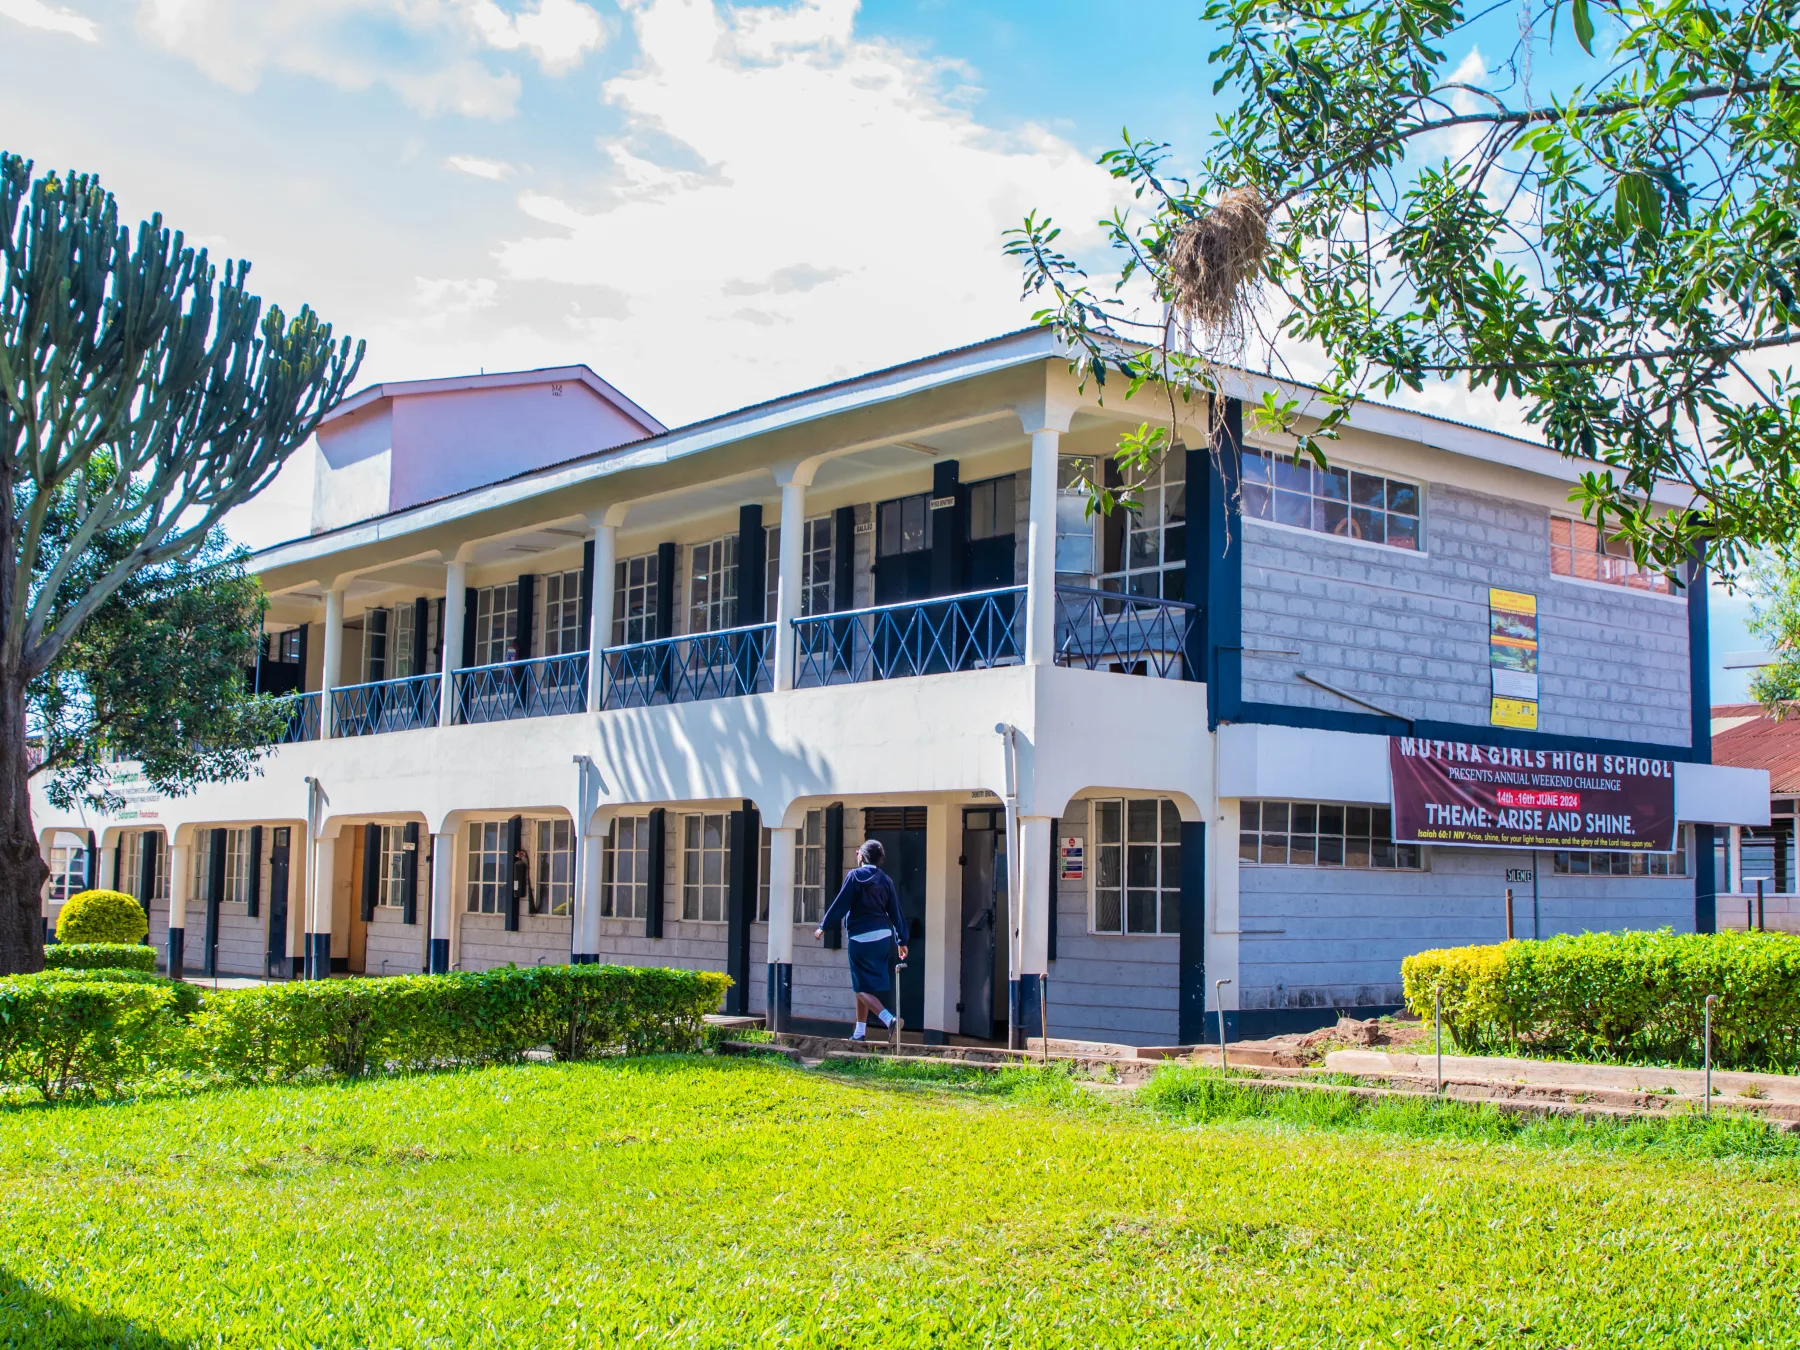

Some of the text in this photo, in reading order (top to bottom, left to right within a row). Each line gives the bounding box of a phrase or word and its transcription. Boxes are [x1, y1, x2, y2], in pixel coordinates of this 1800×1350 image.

[857, 523, 872, 532] GALILEO
[1400, 736, 1672, 778] MUTIRA GIRLS HIGH SCHOOL
[1448, 767, 1621, 791] PRESENTS ANNUAL WEEKEND CHALLENGE
[1497, 792, 1577, 807] 14th -16th JUNE 2024
[1425, 804, 1635, 834] THEME: ARISE AND SHINE.
[1418, 829, 1436, 838] Isaiah
[1453, 831, 1465, 839] NIV
[1484, 833, 1500, 842] shine,
[1510, 835, 1522, 843] your
[1522, 834, 1534, 844] light
[1581, 838, 1593, 847] glory
[1594, 837, 1600, 845] of
[1508, 869, 1531, 881] SILENCE
